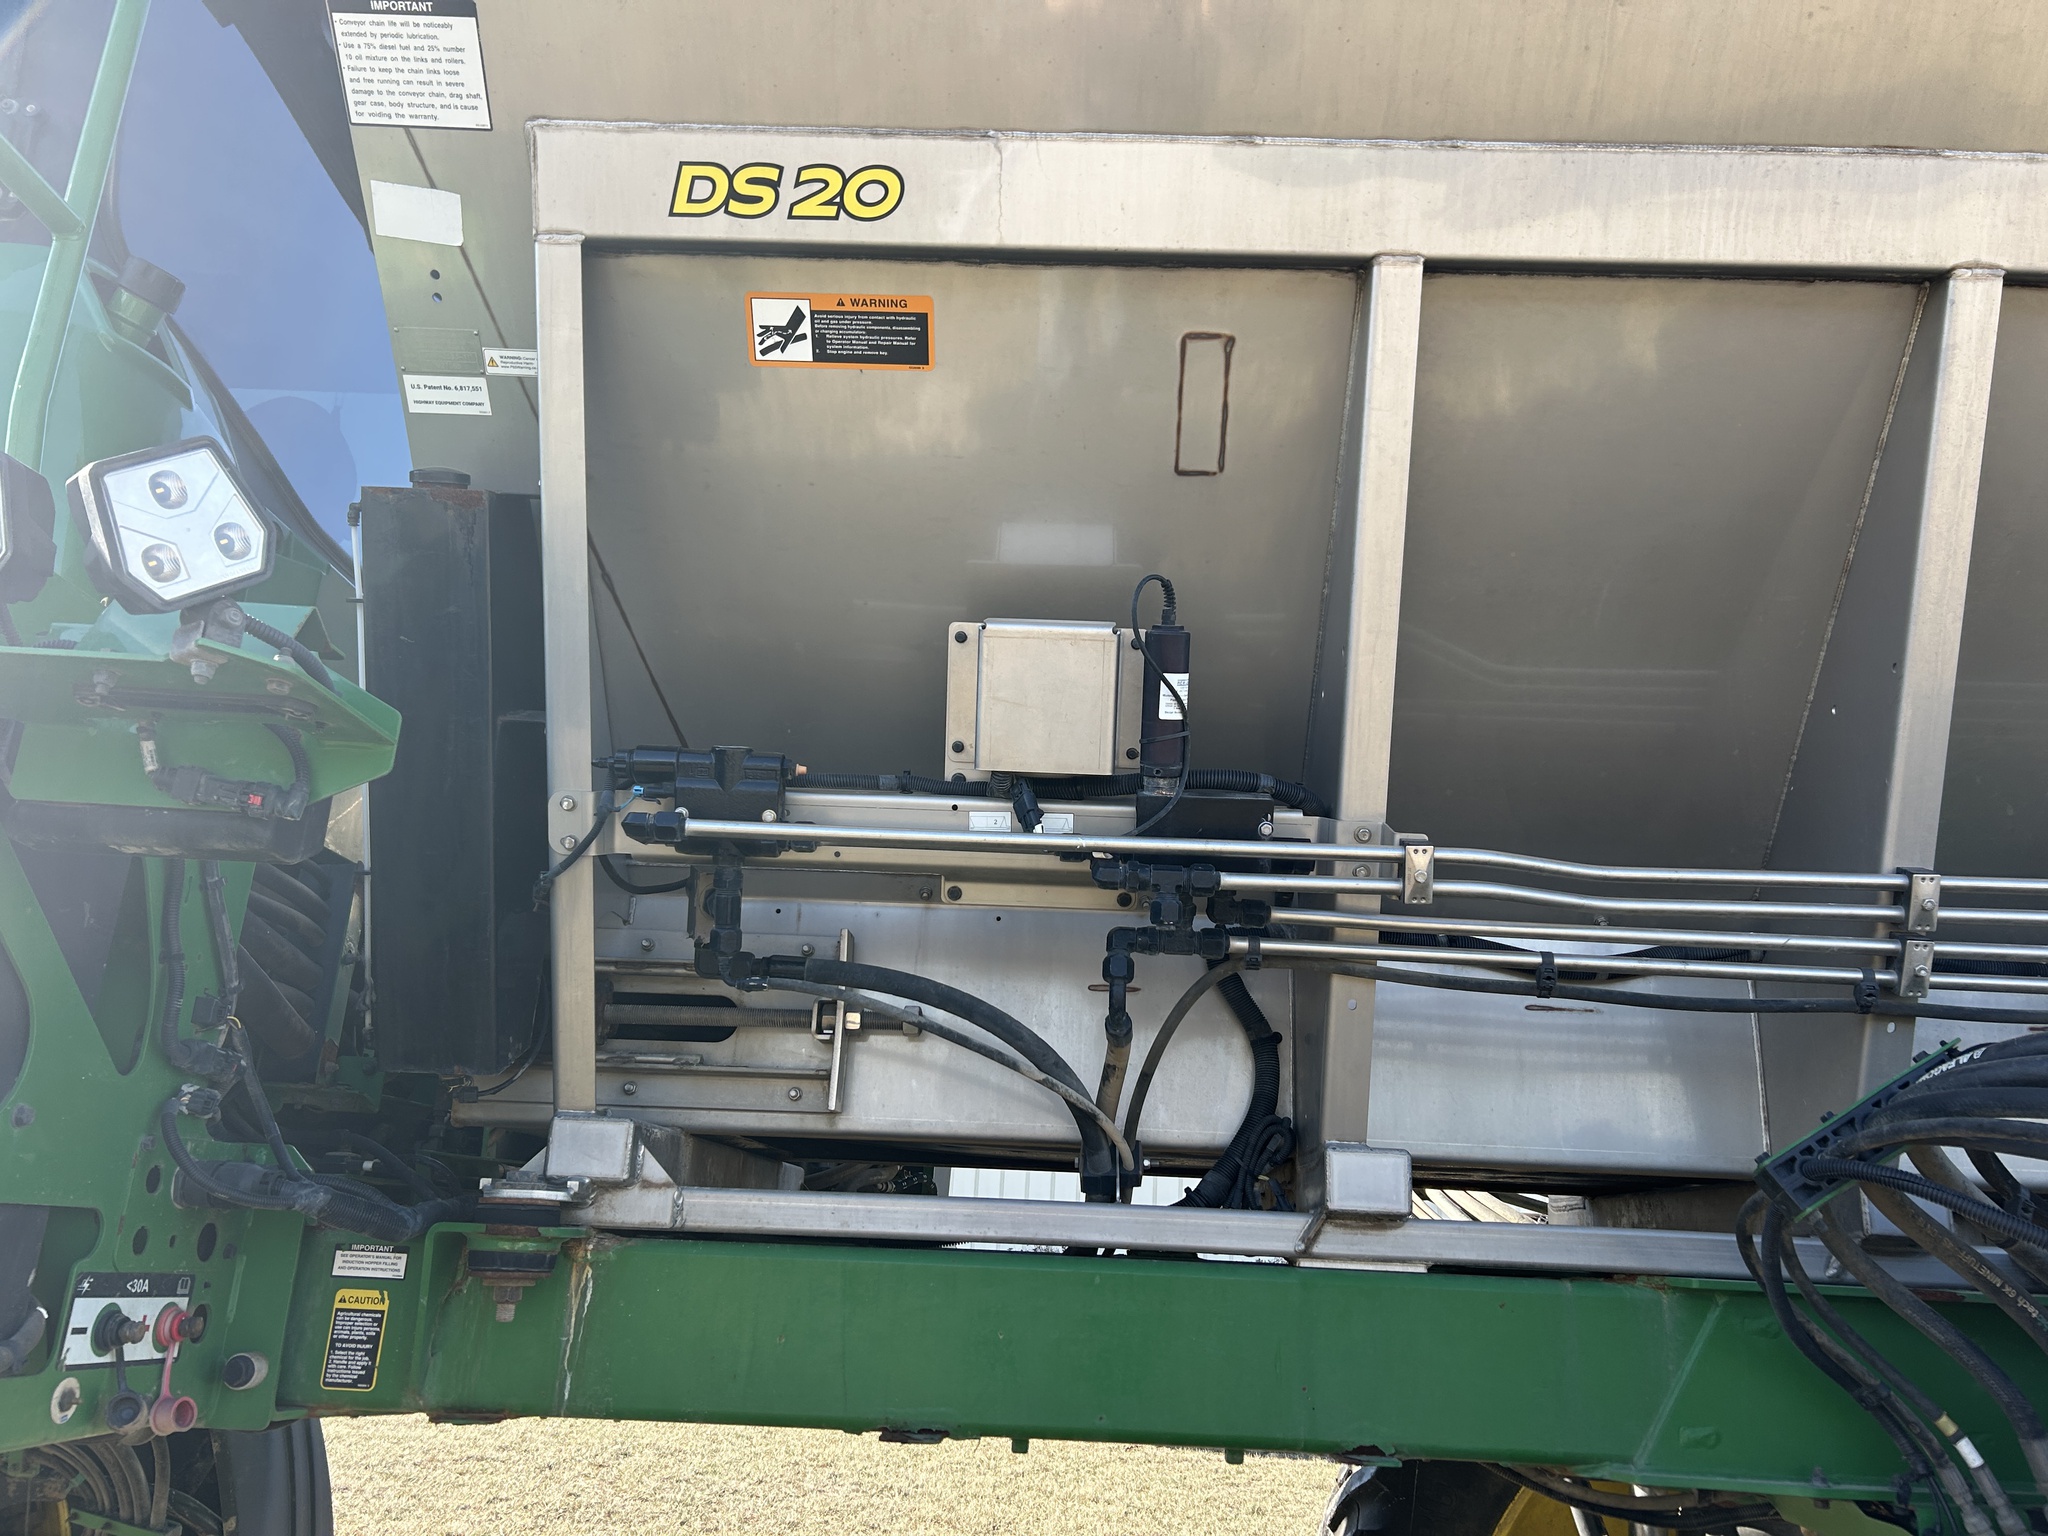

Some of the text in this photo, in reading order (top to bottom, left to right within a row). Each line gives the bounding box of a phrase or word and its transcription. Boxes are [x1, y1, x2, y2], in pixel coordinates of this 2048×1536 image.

[370, 0, 433, 12] IMPORTANT
[339, 18, 366, 27] Conveyor
[423, 22, 453, 30] noticeably
[365, 54, 387, 62] mixture
[445, 57, 466, 65] rollers.
[378, 66, 392, 74] keep
[377, 78, 400, 86] running
[351, 88, 374, 96] damage
[428, 91, 447, 99] chain,
[449, 92, 463, 100] drag
[388, 101, 404, 109] body
[367, 111, 392, 119] voiding
[409, 113, 439, 121] warranty.
[668, 161, 905, 222] DS 20
[850, 298, 908, 308] WARNING
[351, 1244, 394, 1252] IMPORTANT
[126, 1279, 149, 1293] <30A
